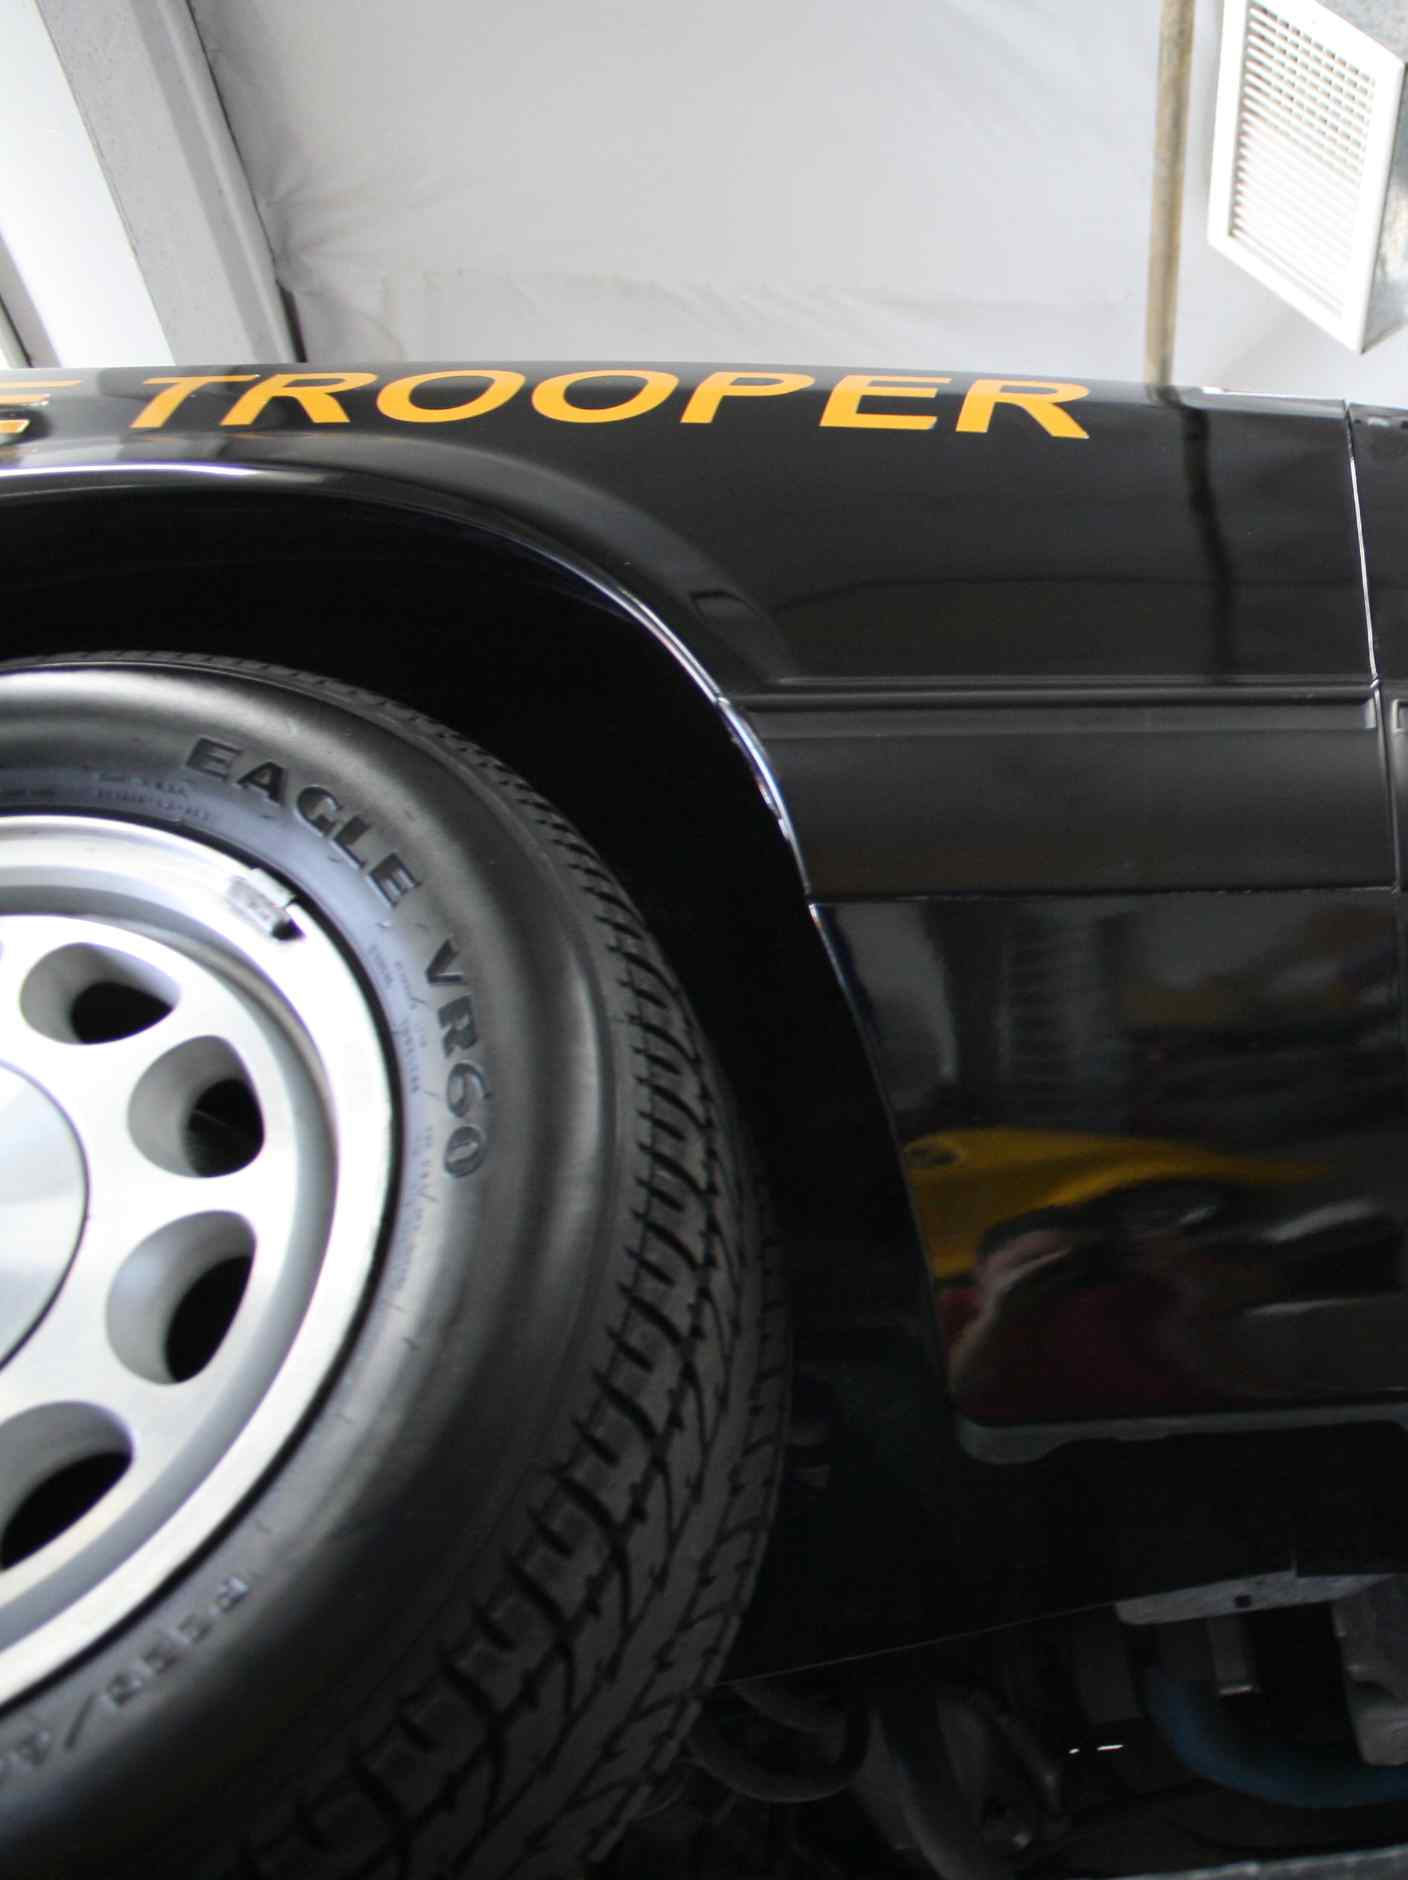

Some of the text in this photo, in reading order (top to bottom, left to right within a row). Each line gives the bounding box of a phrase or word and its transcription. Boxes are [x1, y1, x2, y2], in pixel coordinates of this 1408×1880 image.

[129, 368, 1090, 439] TROOPER
[186, 737, 490, 1179] EAGLE VR60
